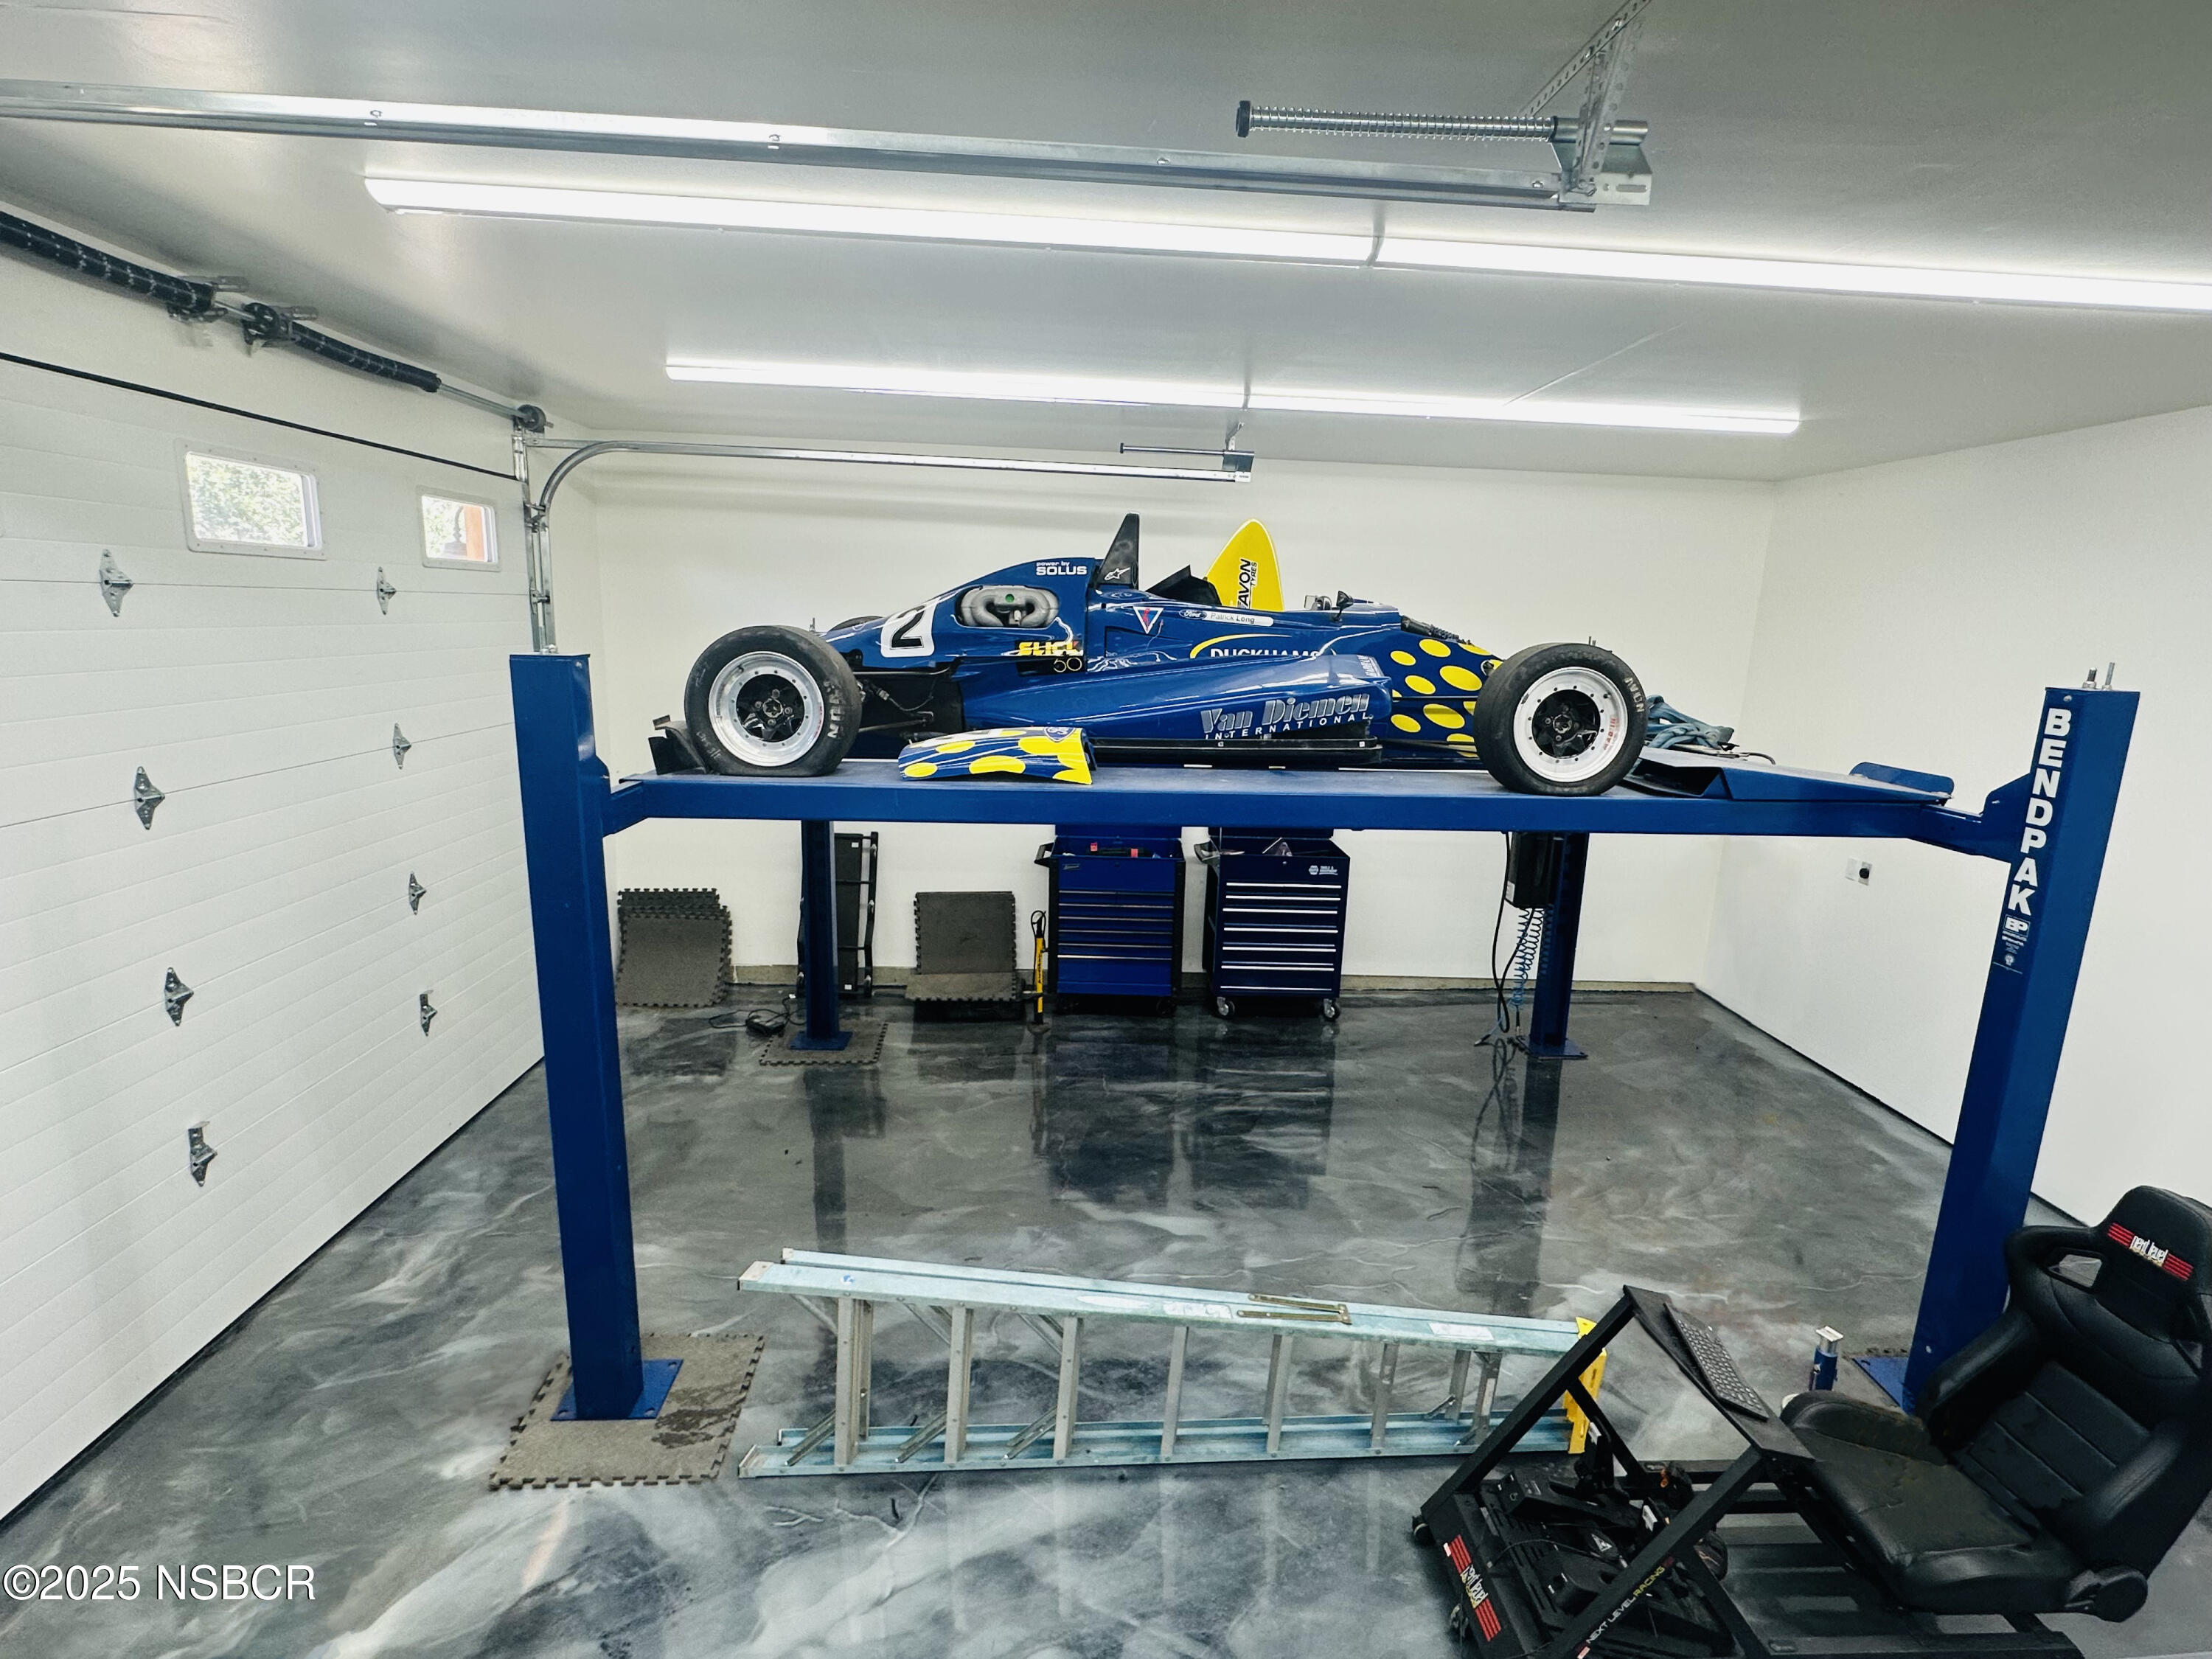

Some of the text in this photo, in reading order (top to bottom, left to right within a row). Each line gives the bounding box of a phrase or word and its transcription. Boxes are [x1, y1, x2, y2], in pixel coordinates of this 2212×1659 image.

[1036, 566, 1088, 575] SOLUS
[1239, 558, 1251, 608] AVON
[890, 605, 925, 649] 2
[1210, 613, 1256, 625] Patrick Long
[1053, 657, 1082, 672] 50
[1200, 694, 1370, 734] Van Diemen
[1204, 712, 1370, 740] INTERNATIONAL
[2008, 708, 2072, 916] BENDPAK
[1585, 1565, 1665, 1644] NEXT LEVEL RACING
